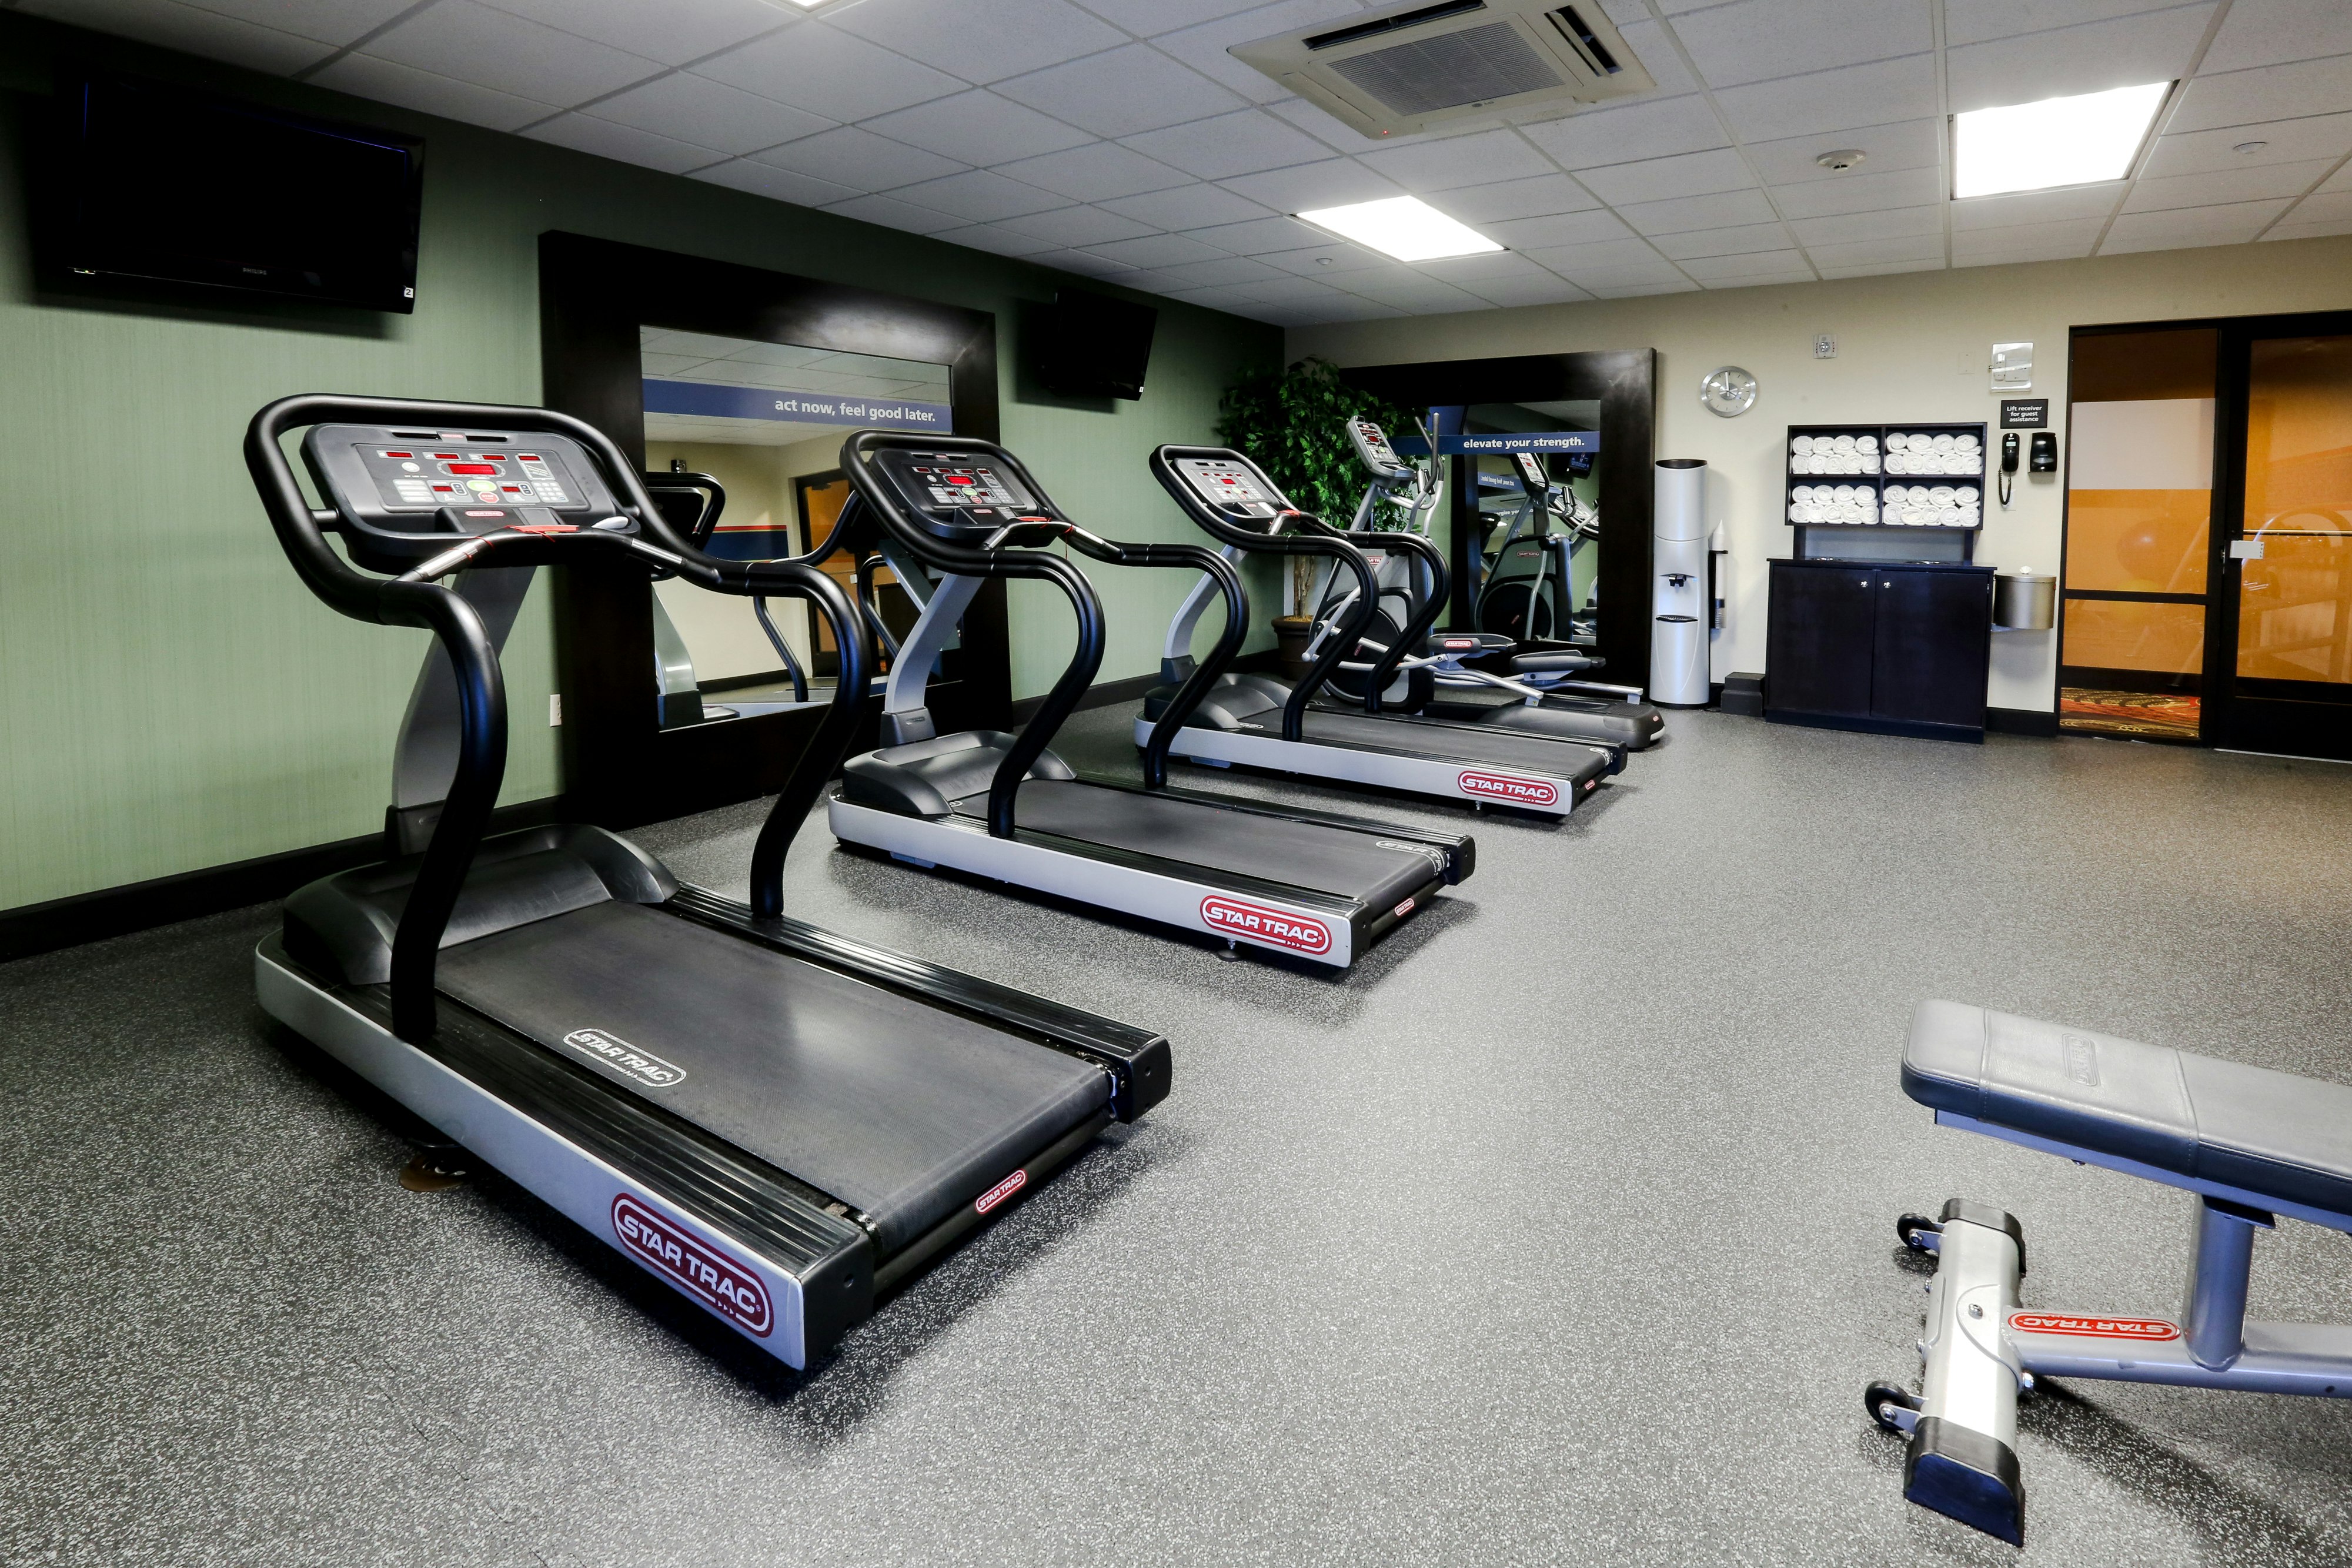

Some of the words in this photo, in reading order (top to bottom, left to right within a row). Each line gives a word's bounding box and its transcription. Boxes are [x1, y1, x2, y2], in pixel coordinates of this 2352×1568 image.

[775, 400, 797, 411] act
[801, 403, 835, 415] now,
[840, 403, 865, 416] feel
[869, 407, 901, 420] good
[905, 408, 936, 422] later.
[1464, 439, 1502, 448] elevate
[1505, 439, 1531, 449] your
[1534, 437, 1585, 448] strength.
[1464, 778, 1504, 792] STAR
[1506, 784, 1549, 798] TRAC
[1207, 907, 1260, 929] STAR
[574, 1033, 622, 1057] STAR
[617, 1053, 671, 1081] TRAC
[979, 1189, 1001, 1208] STAR
[1000, 1174, 1022, 1193] TRAC
[620, 1214, 681, 1267] STAR
[2092, 1321, 2164, 1333] STAR
